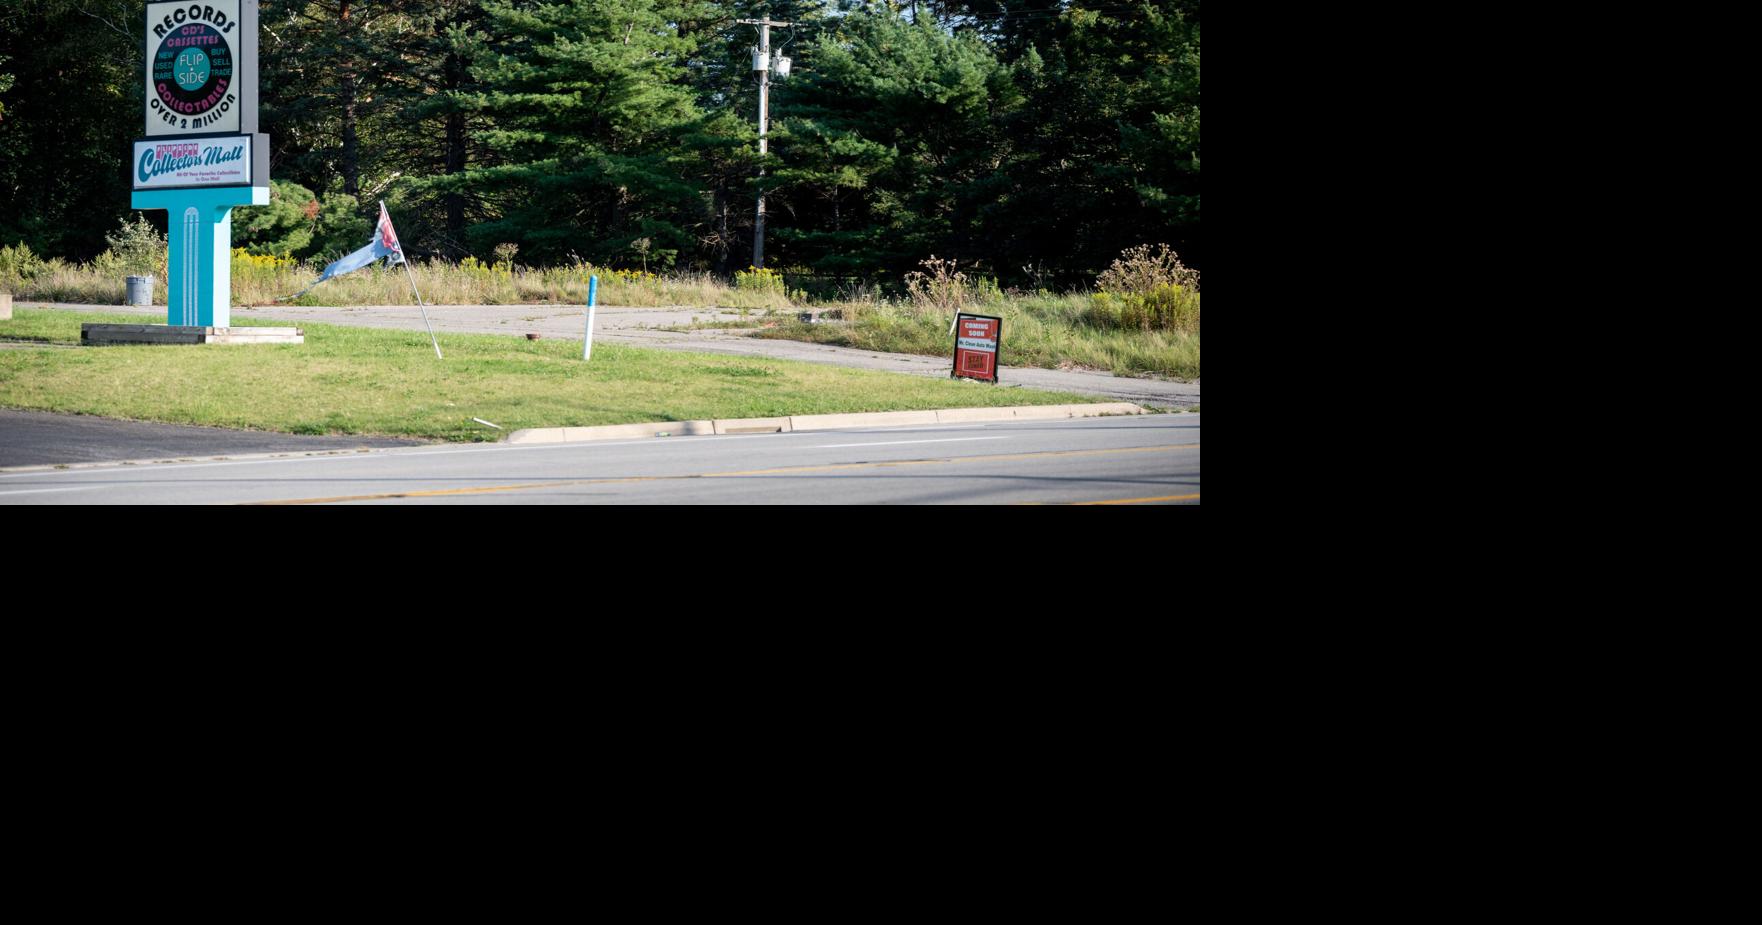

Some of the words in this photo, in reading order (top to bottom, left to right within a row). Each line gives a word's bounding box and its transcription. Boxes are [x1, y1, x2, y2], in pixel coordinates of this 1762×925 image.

[153, 4, 235, 39] RECORDS
[182, 25, 205, 35] CD'S
[167, 35, 219, 47] CASSETTES
[158, 51, 174, 59] NEW
[211, 48, 226, 56] BUY
[180, 53, 204, 66] FLIP
[213, 58, 230, 66] SELL
[155, 62, 173, 70] USED
[155, 72, 173, 80] RARE
[179, 72, 205, 85] SIDE
[158, 78, 227, 112] COLLECTABLES
[151, 98, 177, 127] OVER
[181, 119, 187, 129] 2
[192, 93, 236, 129] MILLION
[138, 148, 202, 183] Collectors
[203, 145, 243, 166] Mall
[965, 322, 989, 330] COMING
